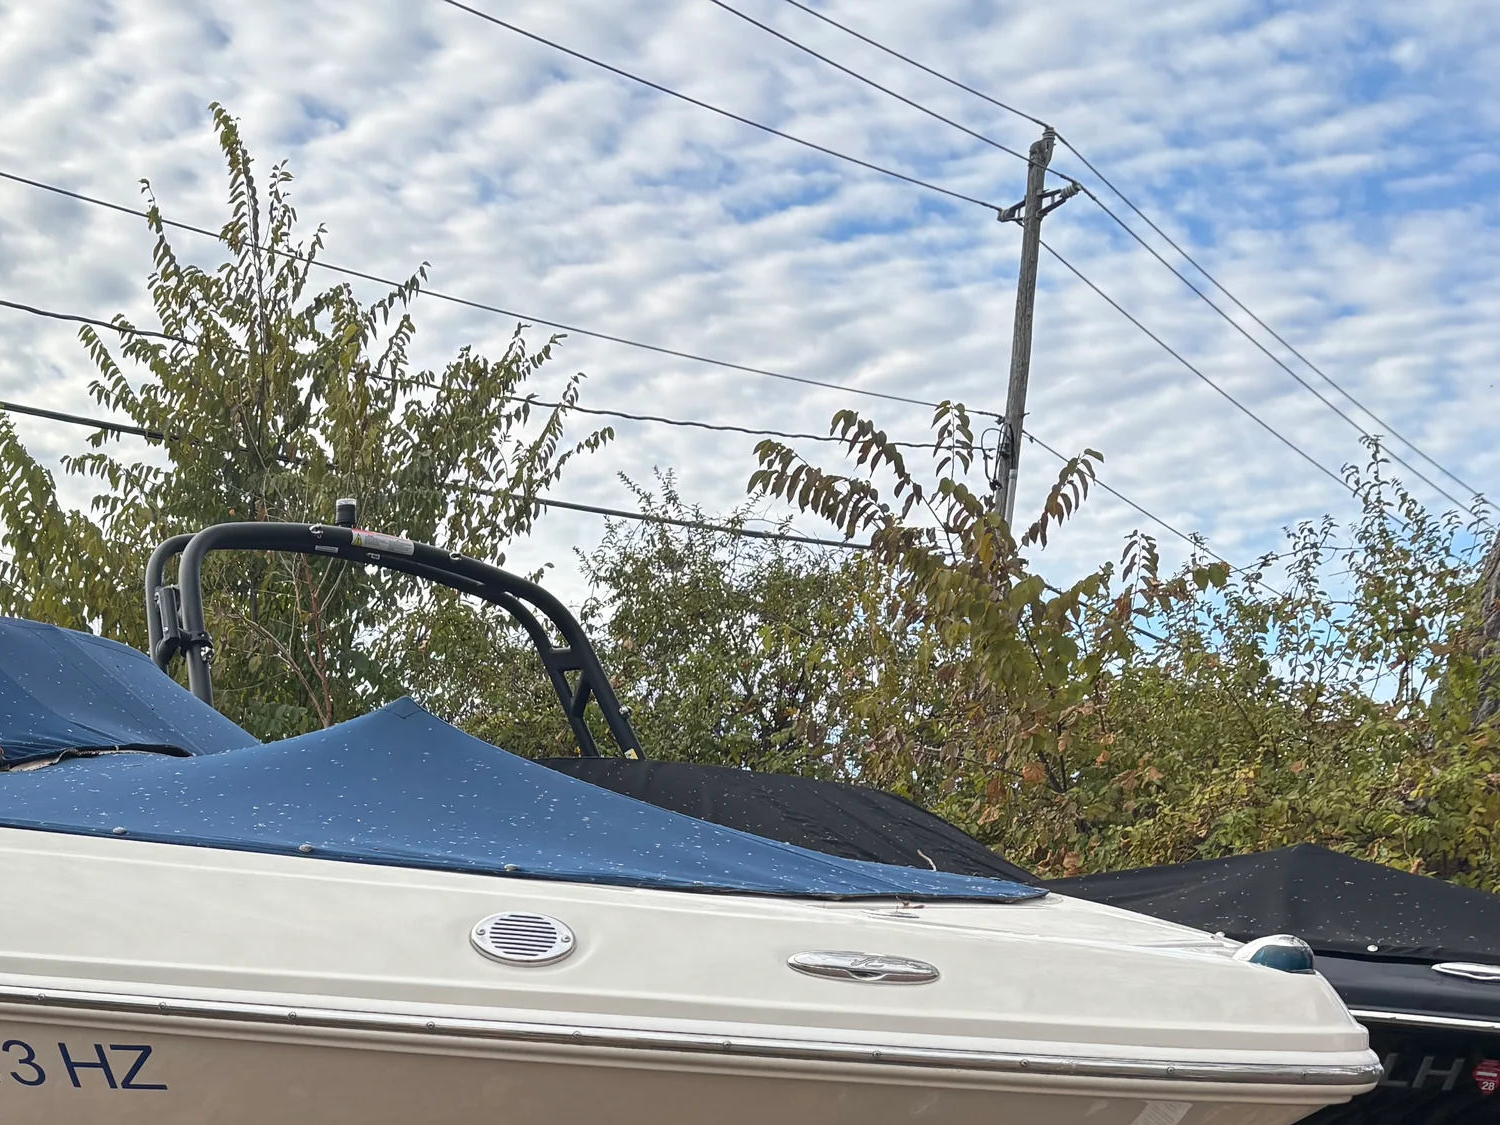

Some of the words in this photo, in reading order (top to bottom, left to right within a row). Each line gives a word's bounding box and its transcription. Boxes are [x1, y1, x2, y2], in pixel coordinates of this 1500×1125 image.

[57, 1042, 168, 1091] HZ
[1377, 1052, 1466, 1091] LH
[1481, 1081, 1495, 1091] 28
